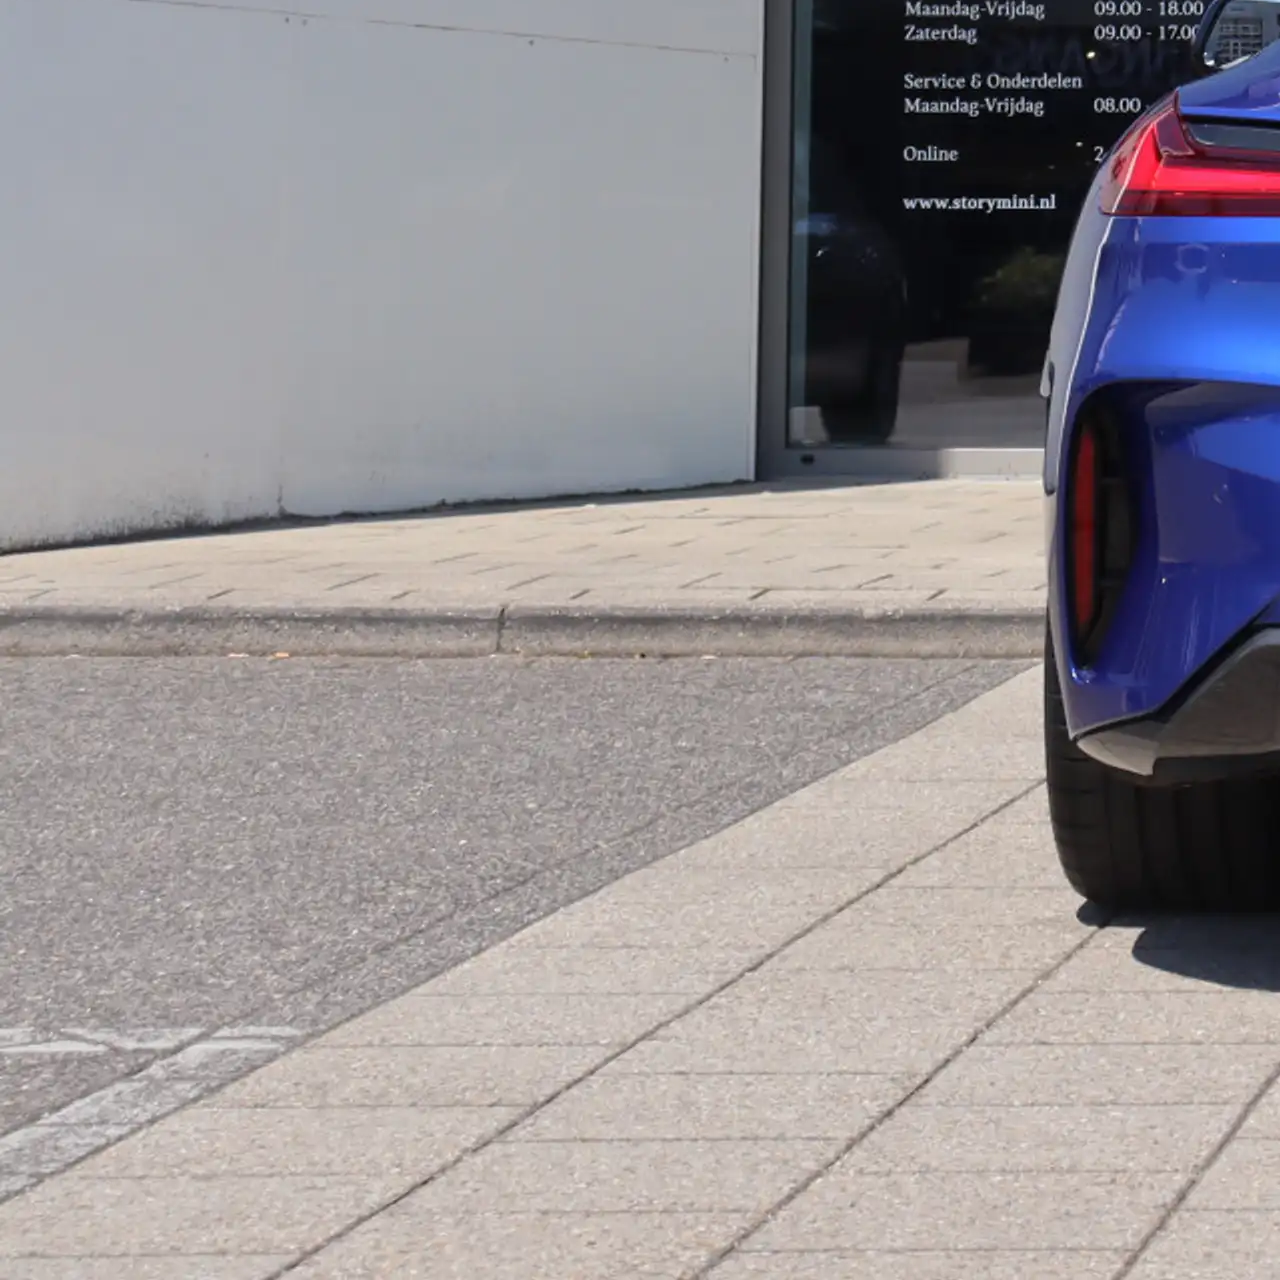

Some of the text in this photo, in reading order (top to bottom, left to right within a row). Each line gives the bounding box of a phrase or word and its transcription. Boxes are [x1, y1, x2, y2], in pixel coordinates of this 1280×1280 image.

[906, 0, 1044, 20] Maandag-Vrijdag
[1095, 1, 1141, 15] 09.00
[1158, 0, 1204, 17] 18.00
[905, 25, 977, 44] Zaterdag
[1095, 25, 1141, 39] 09.00
[904, 73, 1082, 88] Service & Onderdelen
[905, 97, 1142, 116] Maandag-Vrijdag 08.00
[904, 146, 958, 160] Online
[904, 194, 1055, 213] www.storymini.nl
